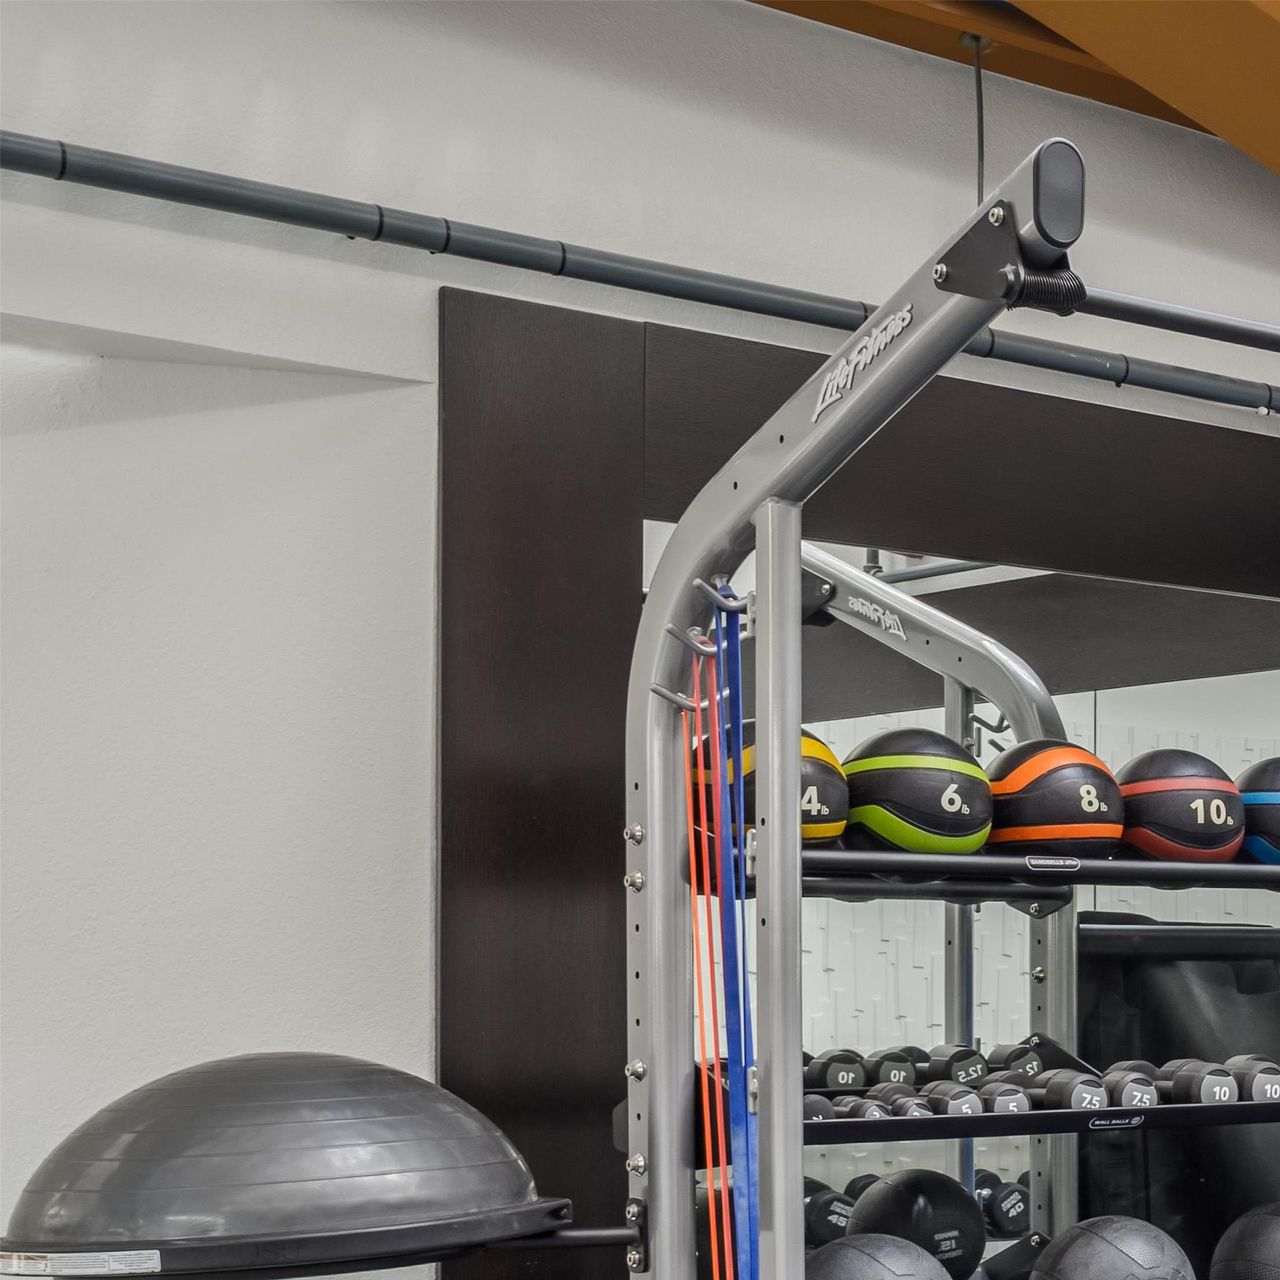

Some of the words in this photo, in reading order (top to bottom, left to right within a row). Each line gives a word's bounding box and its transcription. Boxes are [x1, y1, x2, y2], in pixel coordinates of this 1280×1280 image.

[1213, 1086, 1230, 1101] 10
[1264, 1084, 1280, 1098] 10
[1081, 1093, 1101, 1108] 7.5
[1132, 1091, 1151, 1107] 7.5
[1008, 1202, 1024, 1218] 40
[827, 1213, 848, 1228] 45
